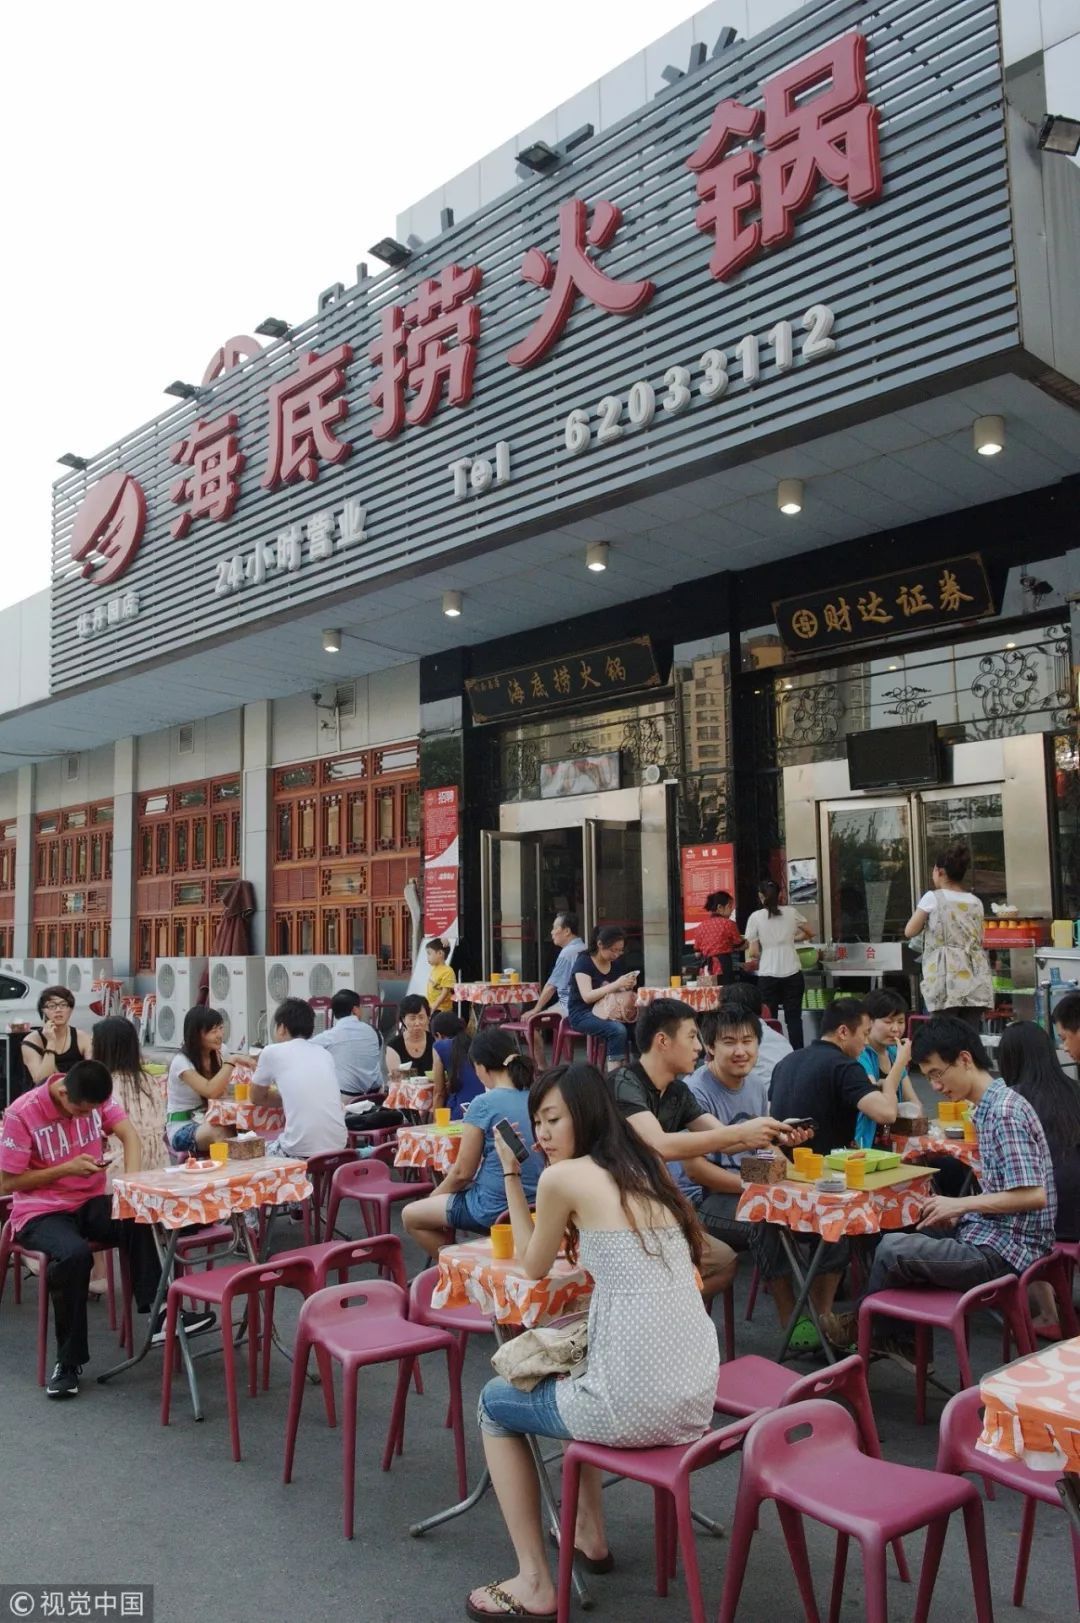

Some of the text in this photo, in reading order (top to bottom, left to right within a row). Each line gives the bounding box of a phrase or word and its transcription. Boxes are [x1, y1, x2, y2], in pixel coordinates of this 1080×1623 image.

[168, 31, 884, 541] 海底捞火锅
[447, 304, 838, 500] Tel 62033112
[215, 497, 369, 597] 24小时营业
[823, 569, 975, 633] 财达证券
[507, 656, 627, 705] 海底捞火锅
[33, 1107, 102, 1162] ITALIA
